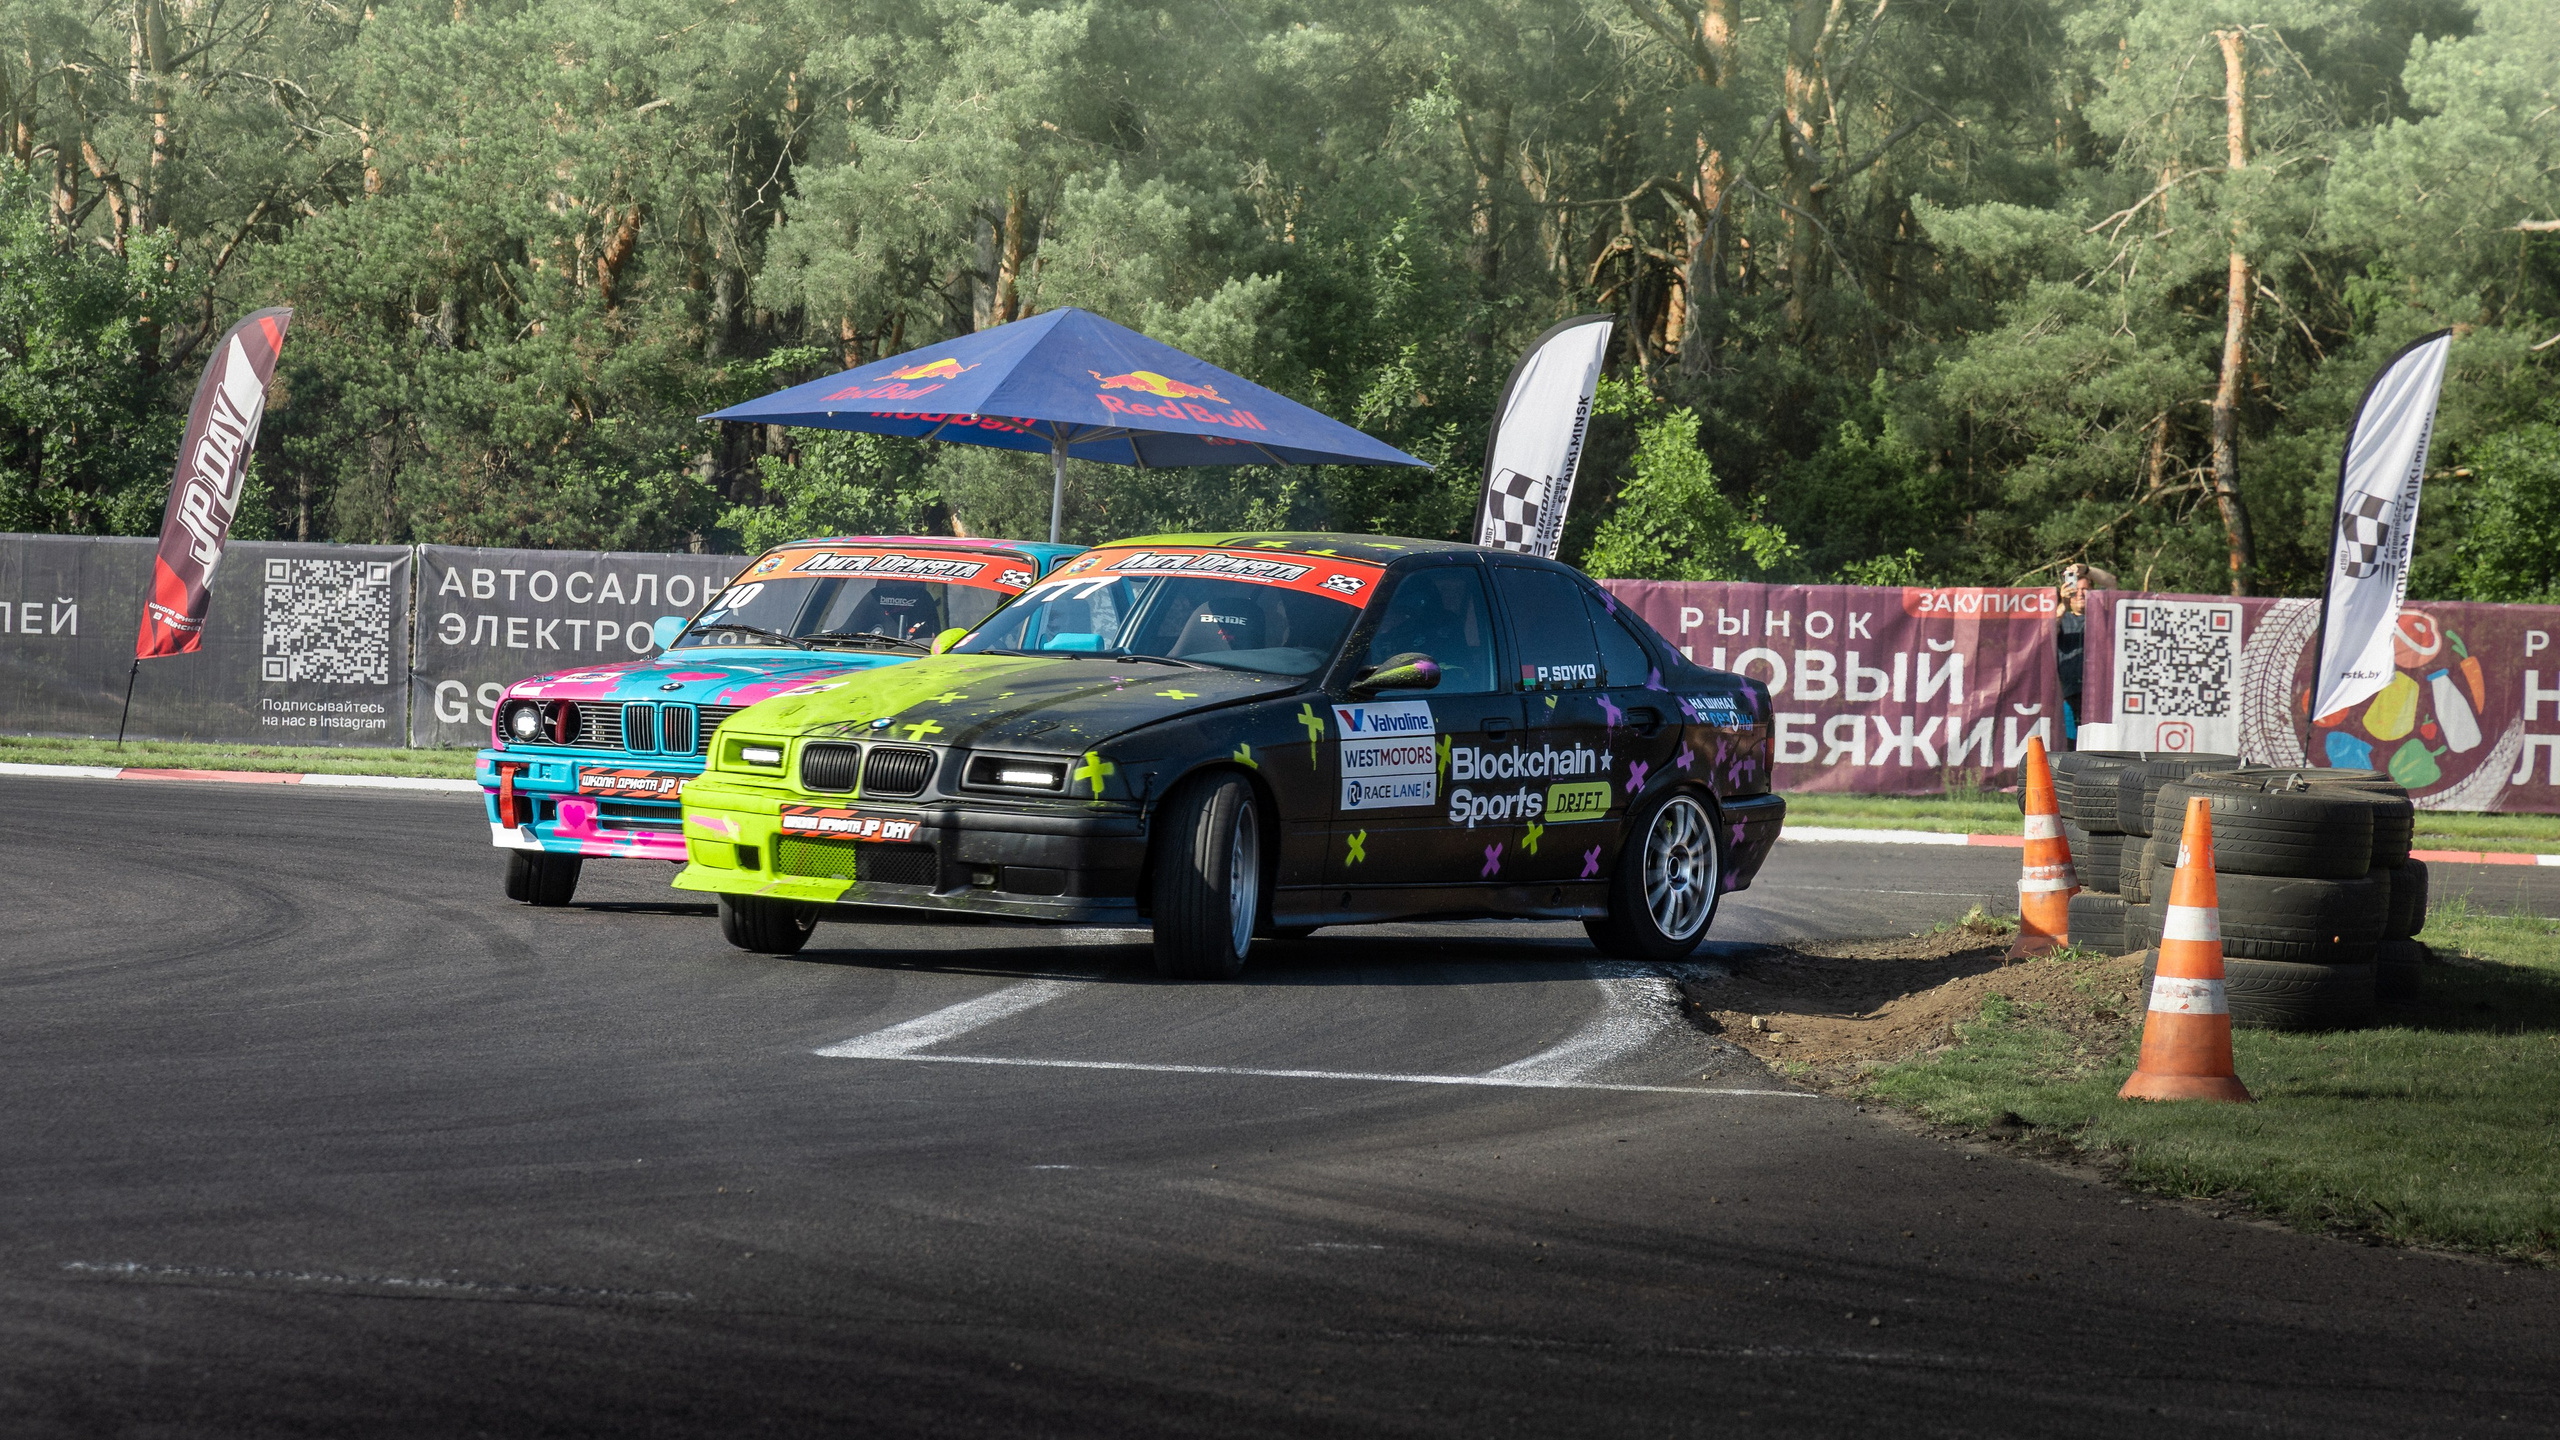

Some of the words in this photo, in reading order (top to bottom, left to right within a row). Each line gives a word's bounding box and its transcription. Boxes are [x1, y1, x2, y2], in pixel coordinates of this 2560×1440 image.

[820, 383, 893, 401] Red
[874, 383, 946, 400] Bull
[1096, 394, 1188, 420] Red
[1181, 402, 1268, 431] Bull
[195, 391, 245, 497] DAY
[180, 481, 222, 564] JP
[1485, 527, 1494, 548] 1967
[712, 583, 764, 611] 10
[1918, 592, 2056, 613] ЗАКУПИСЬ
[1200, 614, 1247, 626] BRIDE
[1680, 606, 1873, 641] РЫНОК
[1538, 664, 1596, 682] P.SOYKO
[2341, 670, 2382, 679] rstk.by
[262, 698, 385, 713] Подписывайтесь
[1688, 698, 1706, 709] НА
[1702, 697, 1737, 710] ШИНАХ
[262, 716, 278, 726] на
[282, 716, 306, 727] нас
[309, 717, 317, 727] в
[320, 715, 386, 730] Instagram
[1367, 712, 1429, 732] Valvoline
[1774, 703, 2050, 768] БЯЖИЙ
[1344, 746, 1432, 768] WESTMOTORS
[1452, 742, 1595, 780] Blockchain
[581, 775, 616, 788] ШКОЛА
[616, 777, 658, 791] ДРИФТА
[658, 778, 675, 794] JP
[1364, 785, 1391, 799] RACE
[1393, 783, 1421, 798] LANE
[1449, 786, 1543, 828] Sports
[1555, 792, 1603, 813] DRIFT
[860, 820, 881, 837] JP
[881, 821, 918, 840] DAY
